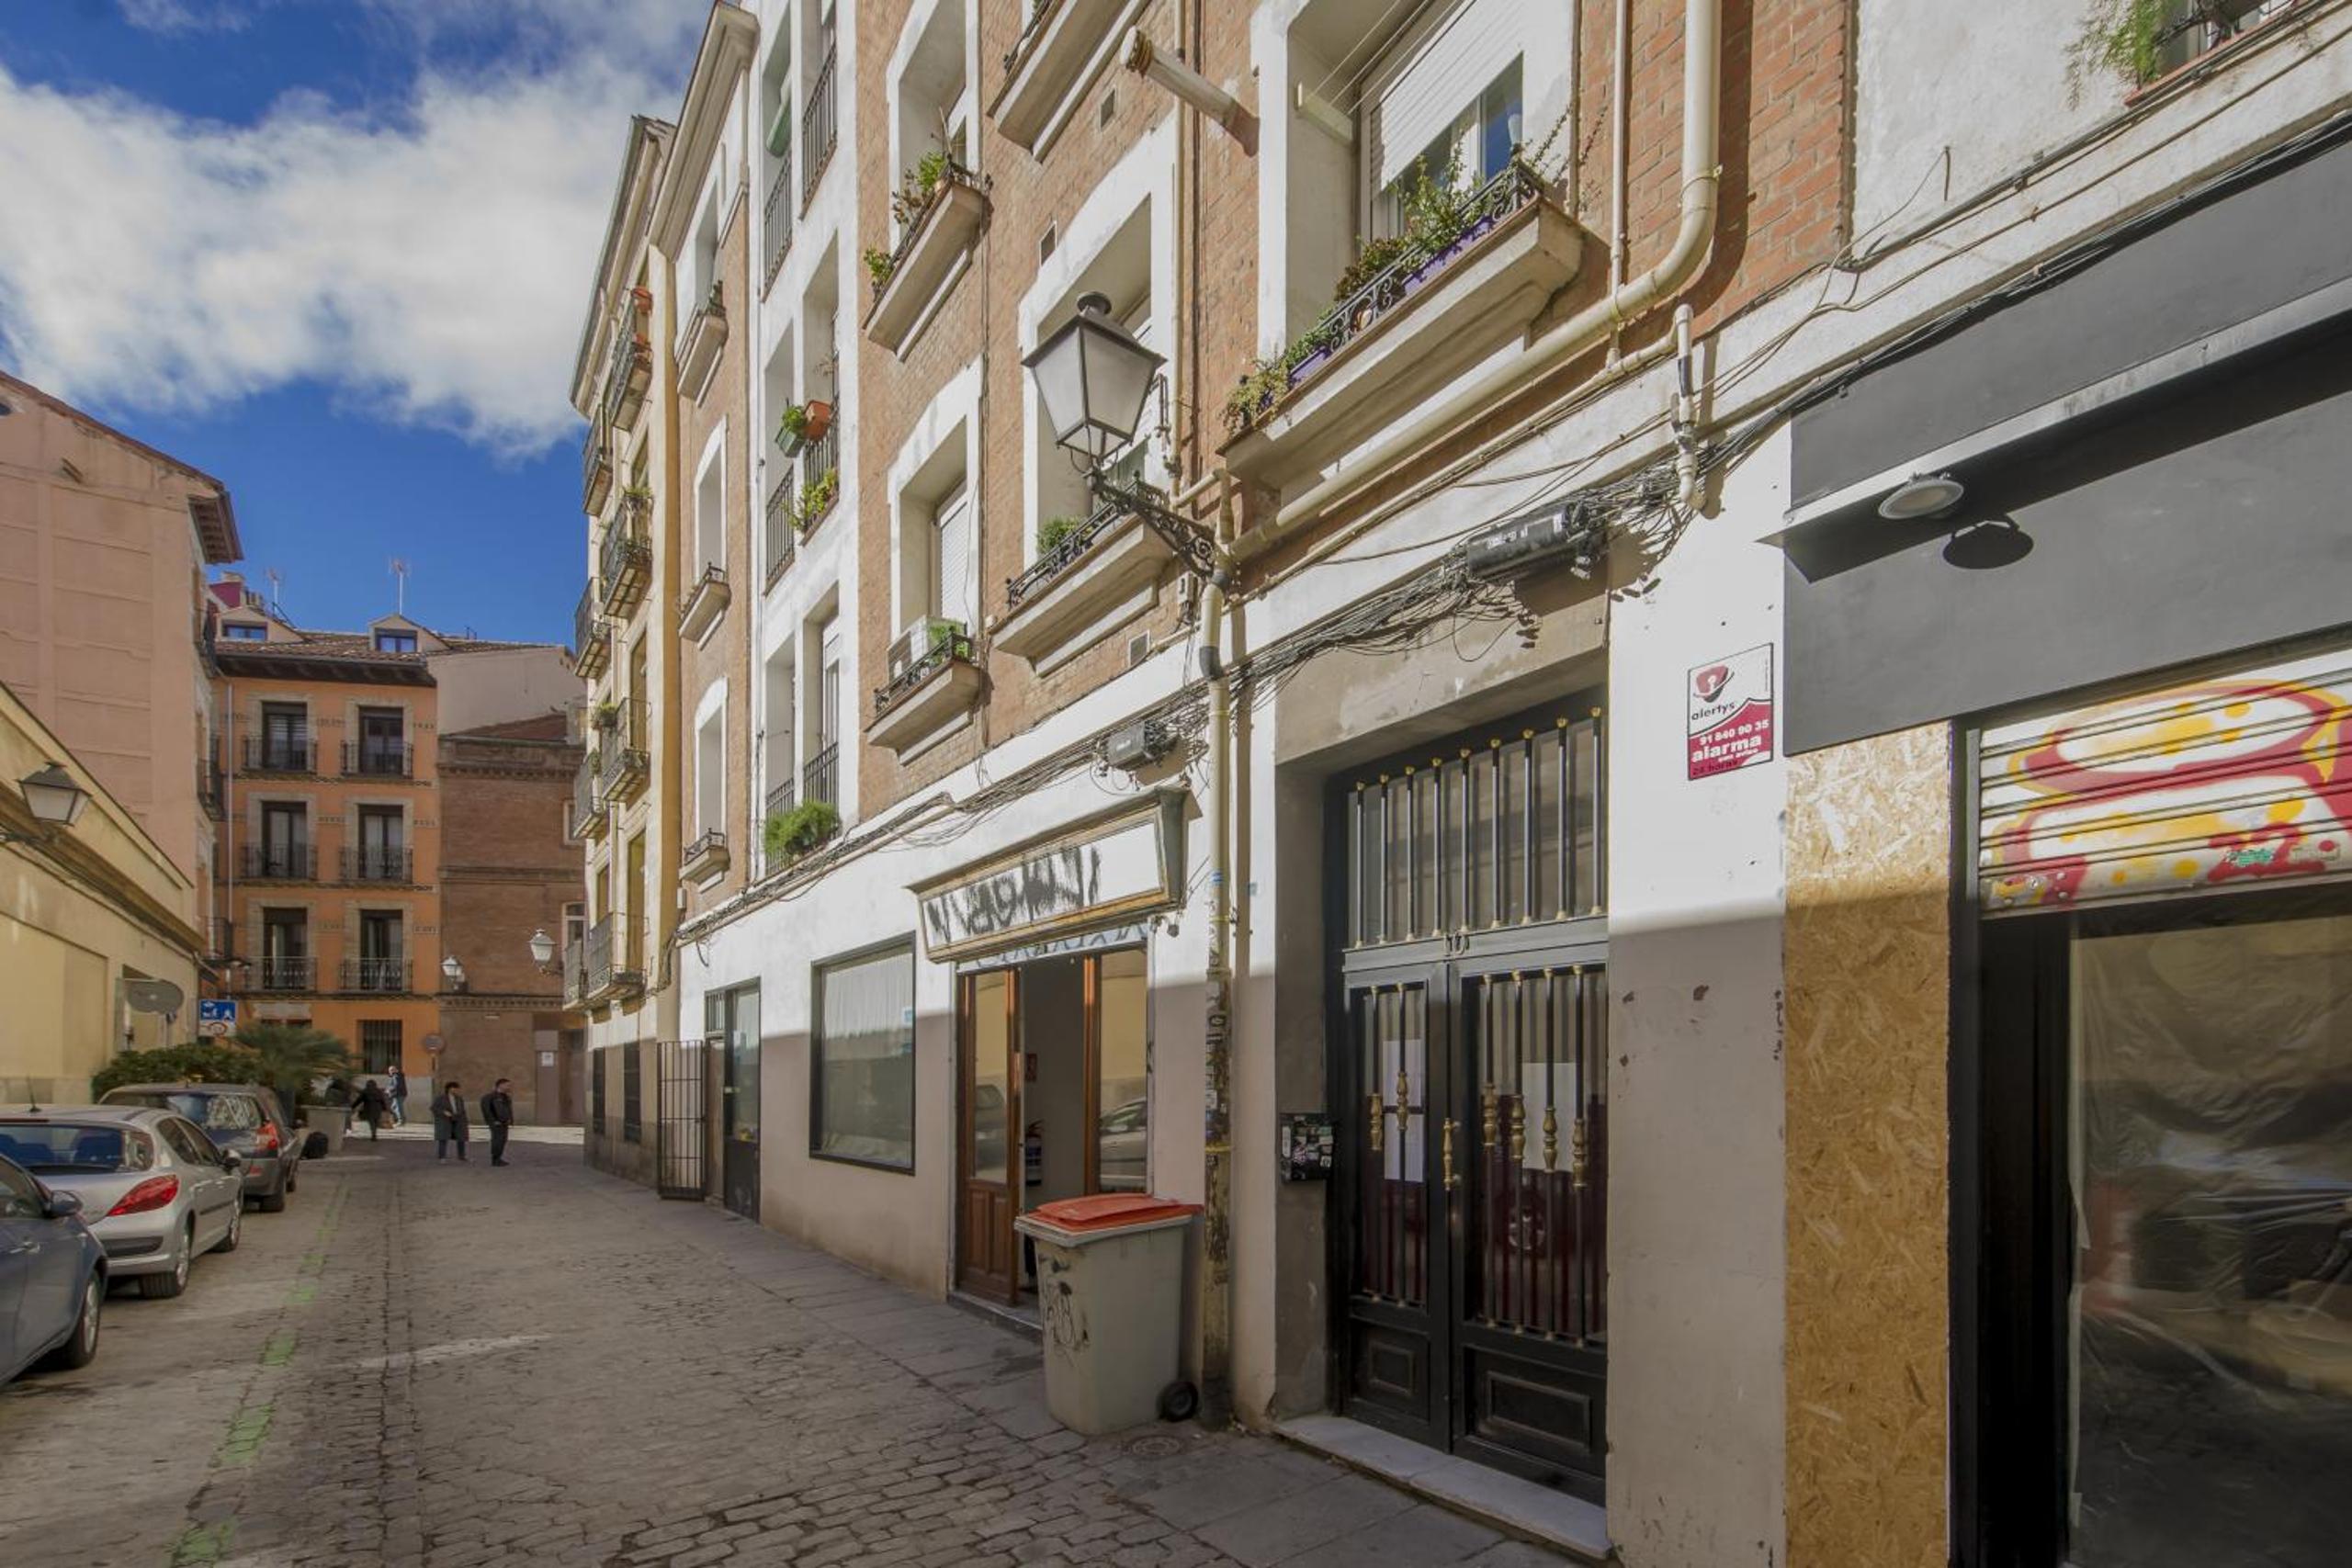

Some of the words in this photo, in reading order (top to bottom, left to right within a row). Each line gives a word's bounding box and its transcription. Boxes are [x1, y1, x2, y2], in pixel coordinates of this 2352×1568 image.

[1691, 702, 1736, 720] alertys
[1699, 734, 1713, 746] 91
[1755, 719, 1770, 731] 35
[1691, 735, 1762, 762] alarma
